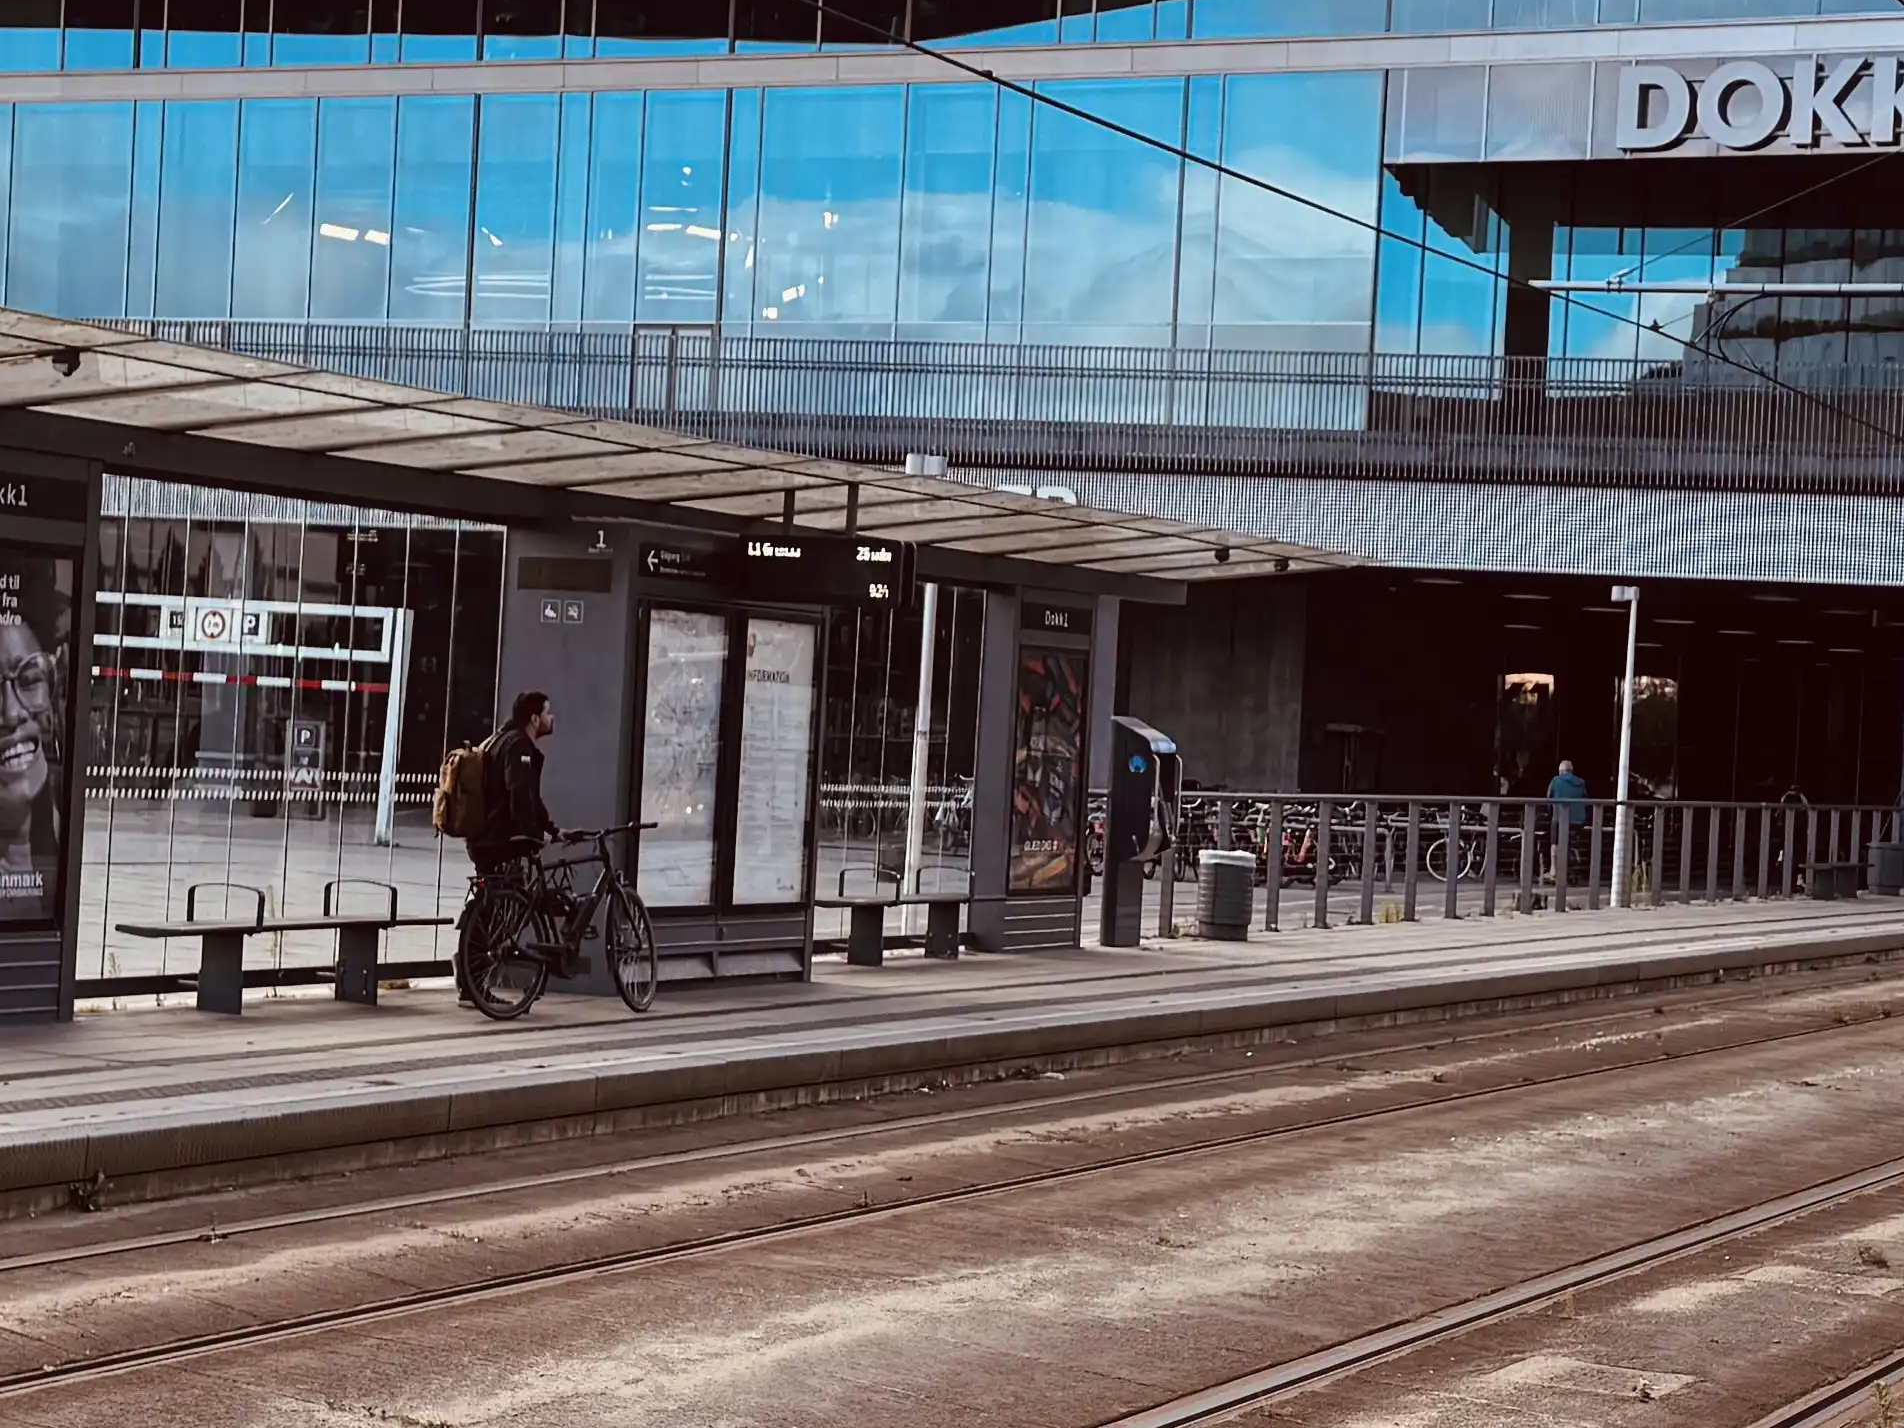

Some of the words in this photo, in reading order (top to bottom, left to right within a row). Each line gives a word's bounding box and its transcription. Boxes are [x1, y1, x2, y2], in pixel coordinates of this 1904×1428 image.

[596, 530, 607, 548] 1
[8, 575, 20, 590] til
[2, 592, 18, 608] fra
[300, 729, 311, 744] P
